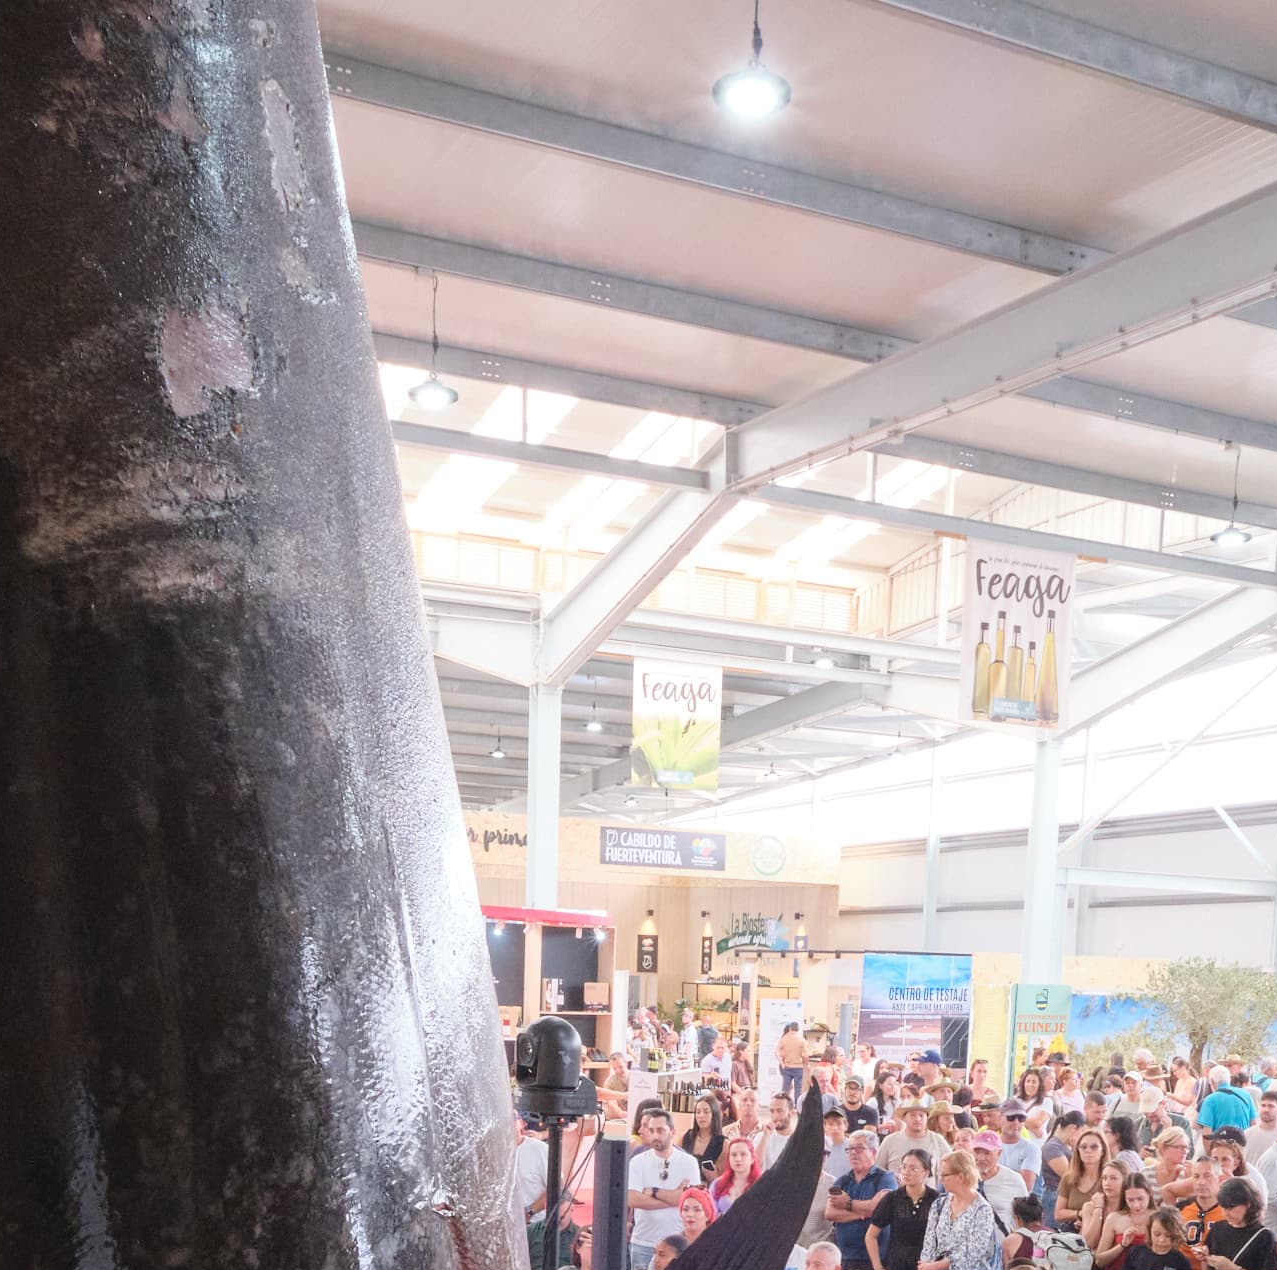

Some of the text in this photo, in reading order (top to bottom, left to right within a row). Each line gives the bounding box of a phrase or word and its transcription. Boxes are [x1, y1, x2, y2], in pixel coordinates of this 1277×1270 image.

[976, 558, 1071, 618] Feaga
[643, 672, 717, 712] Feaga
[621, 831, 677, 849] CABILDO DE
[605, 847, 682, 866] FUERTEVENTURA
[889, 986, 968, 1001] CENTRO DE TESTAJE
[1017, 1022, 1067, 1033] TUINEJE
